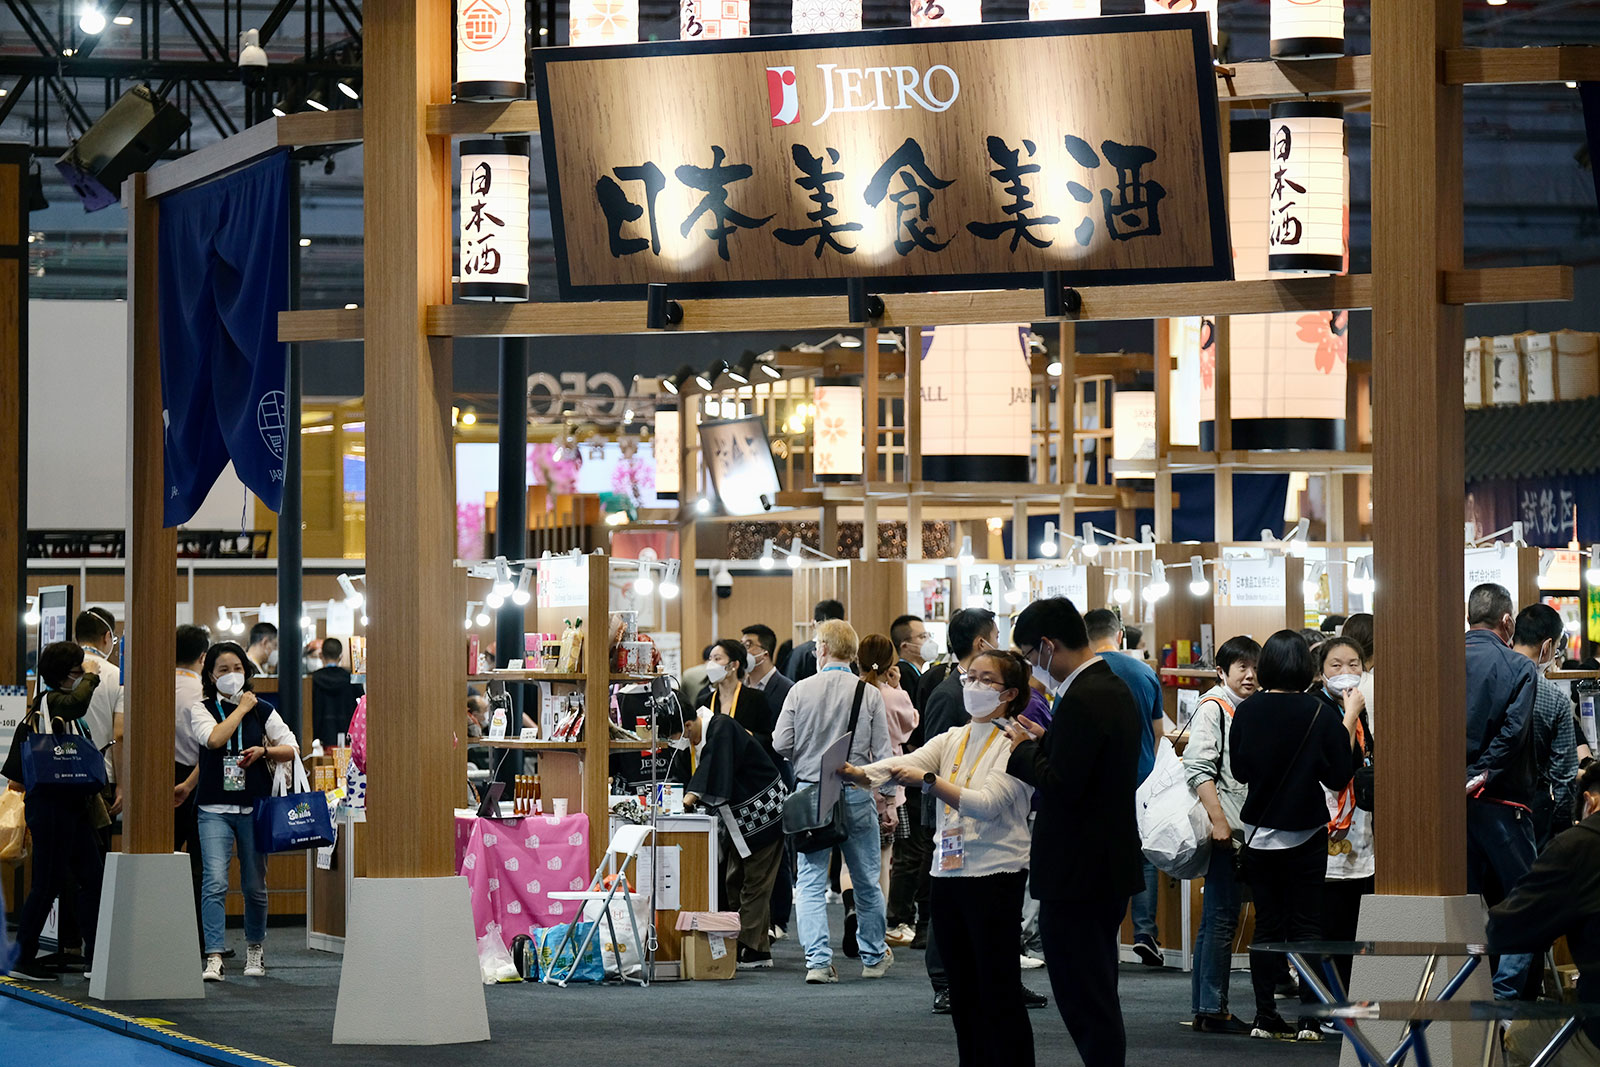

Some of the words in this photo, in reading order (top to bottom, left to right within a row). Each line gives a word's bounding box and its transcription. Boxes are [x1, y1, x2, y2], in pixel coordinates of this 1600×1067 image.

[812, 63, 961, 126] JETRO
[464, 161, 505, 275] 日本酒
[595, 134, 1167, 261] 日本美食美酒
[1269, 124, 1307, 247] 日本酒
